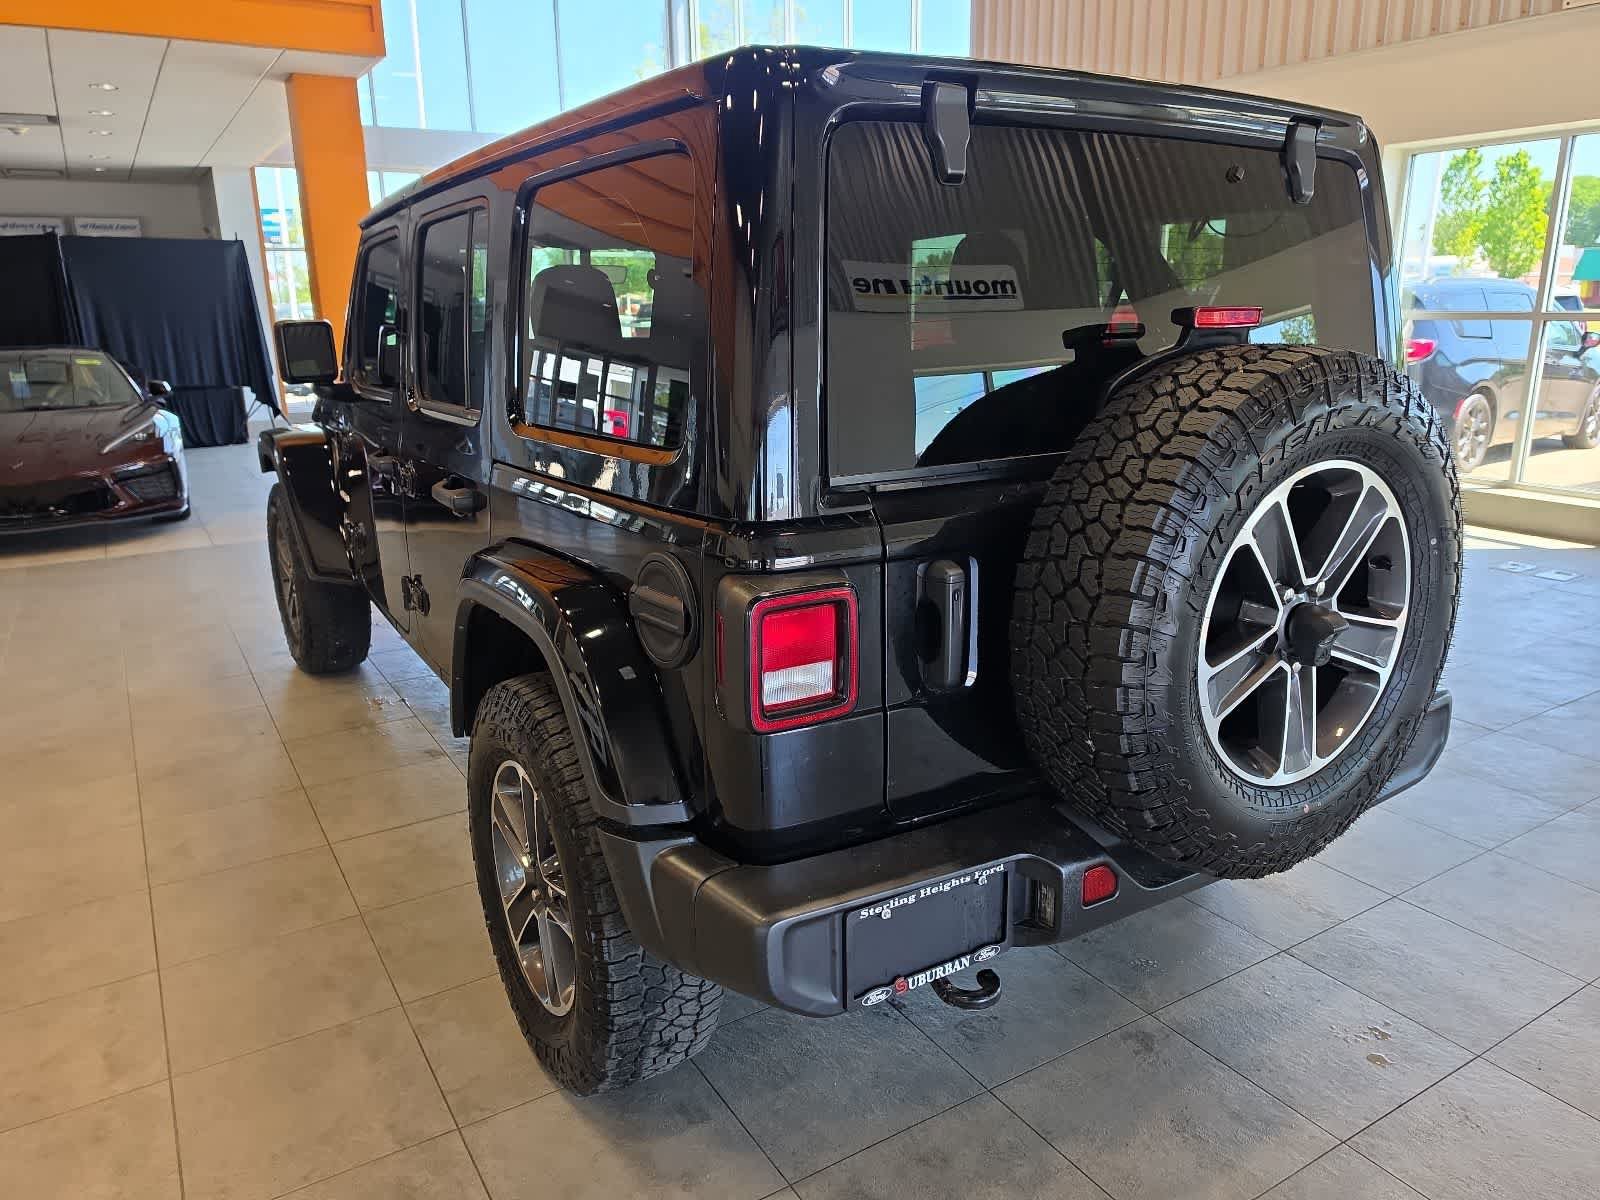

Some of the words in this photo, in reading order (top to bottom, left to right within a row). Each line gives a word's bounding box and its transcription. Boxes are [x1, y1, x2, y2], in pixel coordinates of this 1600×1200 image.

[860, 894, 916, 919] Sterling
[919, 876, 971, 898] Heights
[974, 864, 1004, 880] Ford
[865, 987, 890, 1005] Ford
[894, 955, 971, 995] SUBURBAN
[977, 946, 998, 961] Ford
